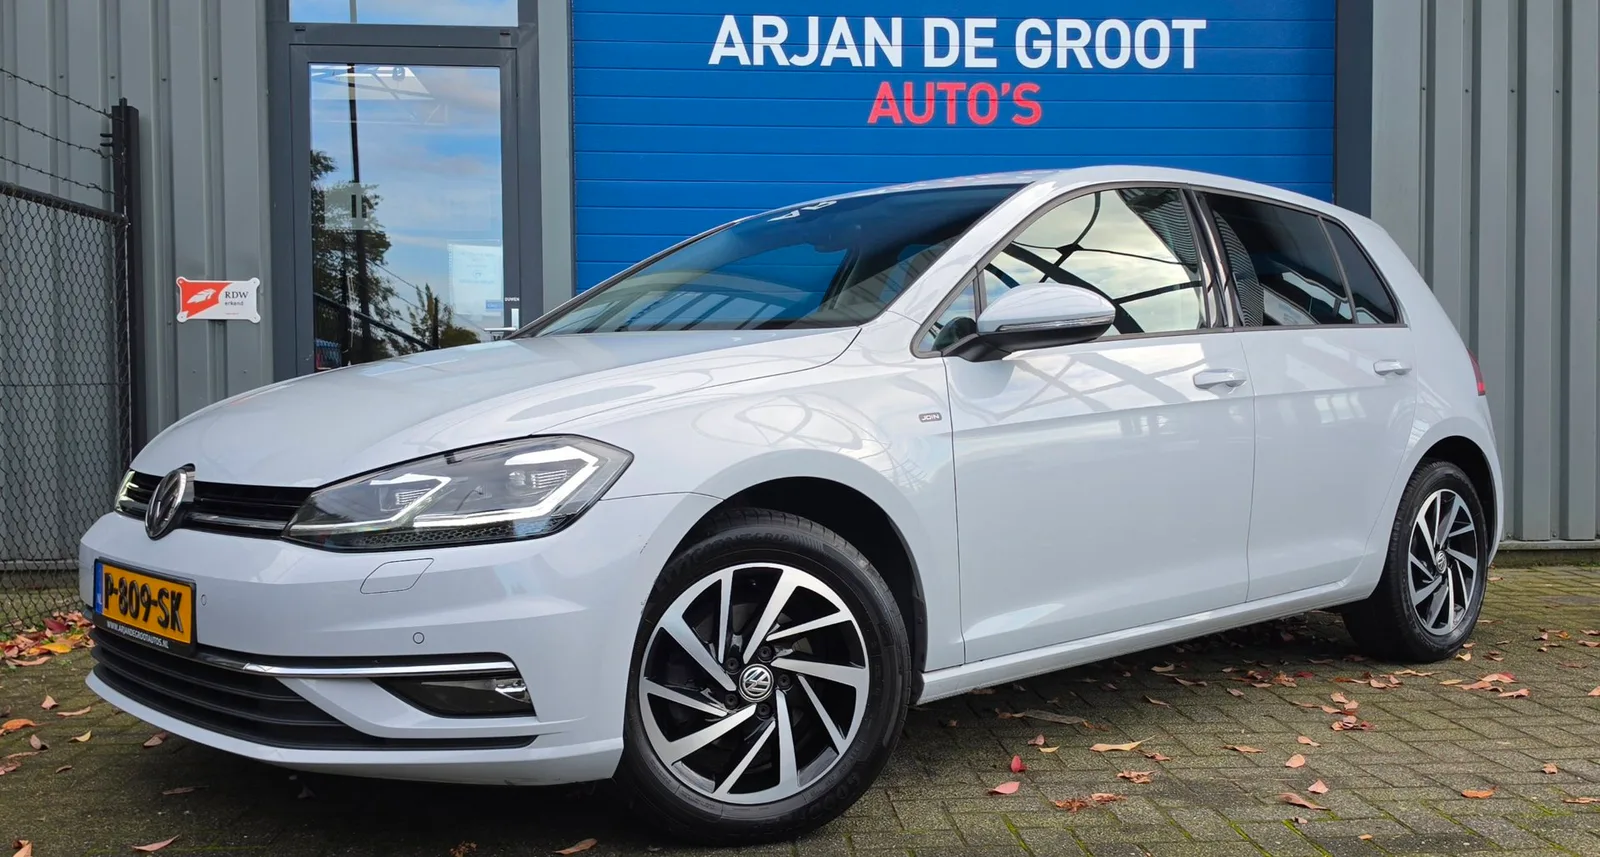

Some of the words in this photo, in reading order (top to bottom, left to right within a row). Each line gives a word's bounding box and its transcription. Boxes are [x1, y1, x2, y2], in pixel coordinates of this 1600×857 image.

[708, 15, 902, 68] ARJAN
[923, 18, 998, 69] DE
[1014, 19, 1207, 70] GROOT
[867, 81, 1042, 126] AUTO'S
[224, 291, 249, 299] RDW
[921, 413, 940, 421] JOIN
[104, 572, 184, 634] P-809-SK
